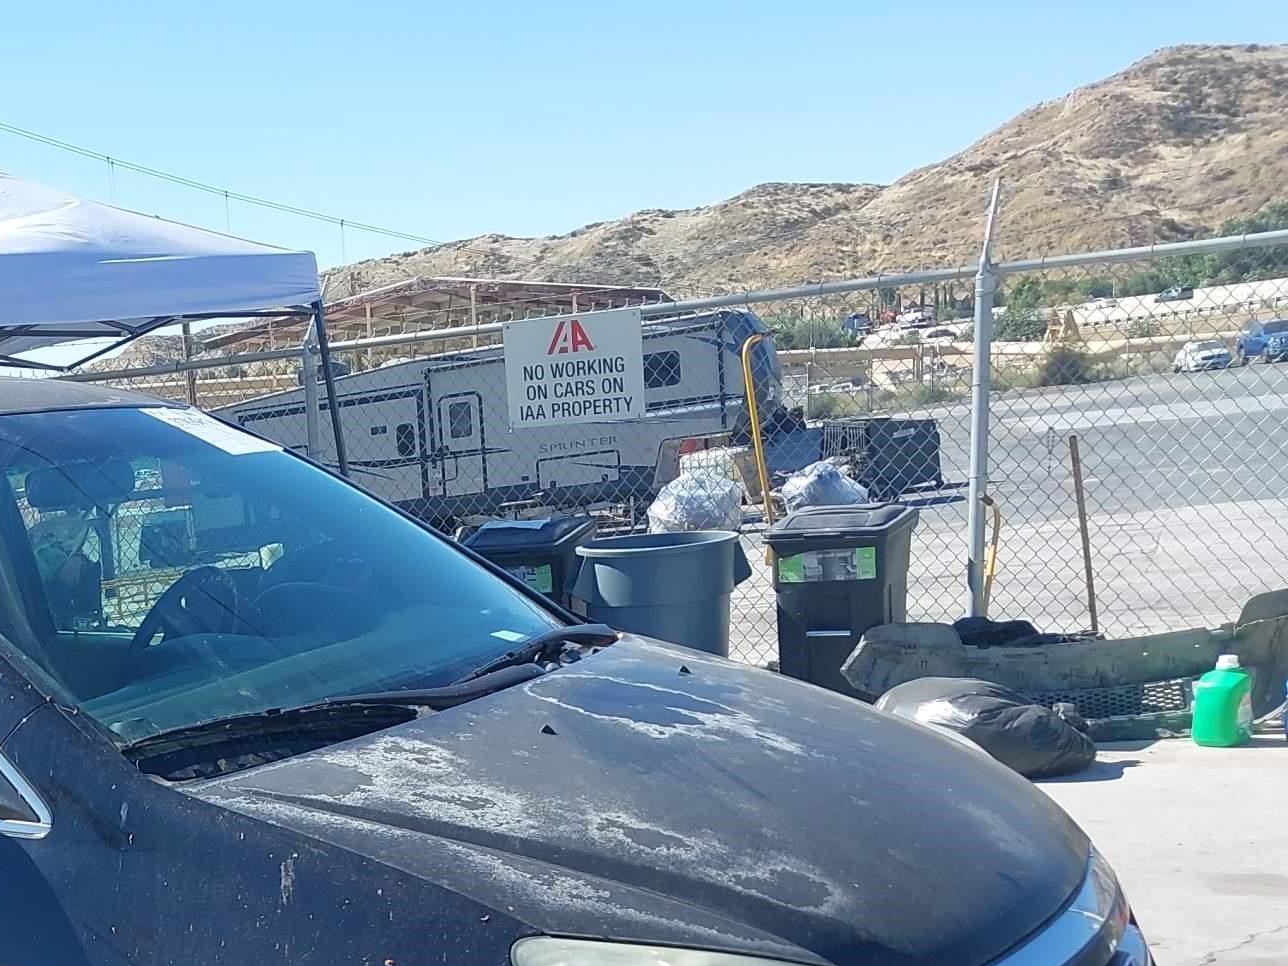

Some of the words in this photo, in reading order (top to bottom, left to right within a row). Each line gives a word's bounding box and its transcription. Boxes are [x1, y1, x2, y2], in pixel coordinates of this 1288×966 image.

[523, 364, 544, 381] NO
[550, 356, 625, 378] WORKING
[526, 385, 548, 401] ON
[553, 379, 595, 399] CARS
[601, 377, 625, 394] ON
[520, 404, 546, 421] IAA
[551, 396, 633, 418] PROPERTY
